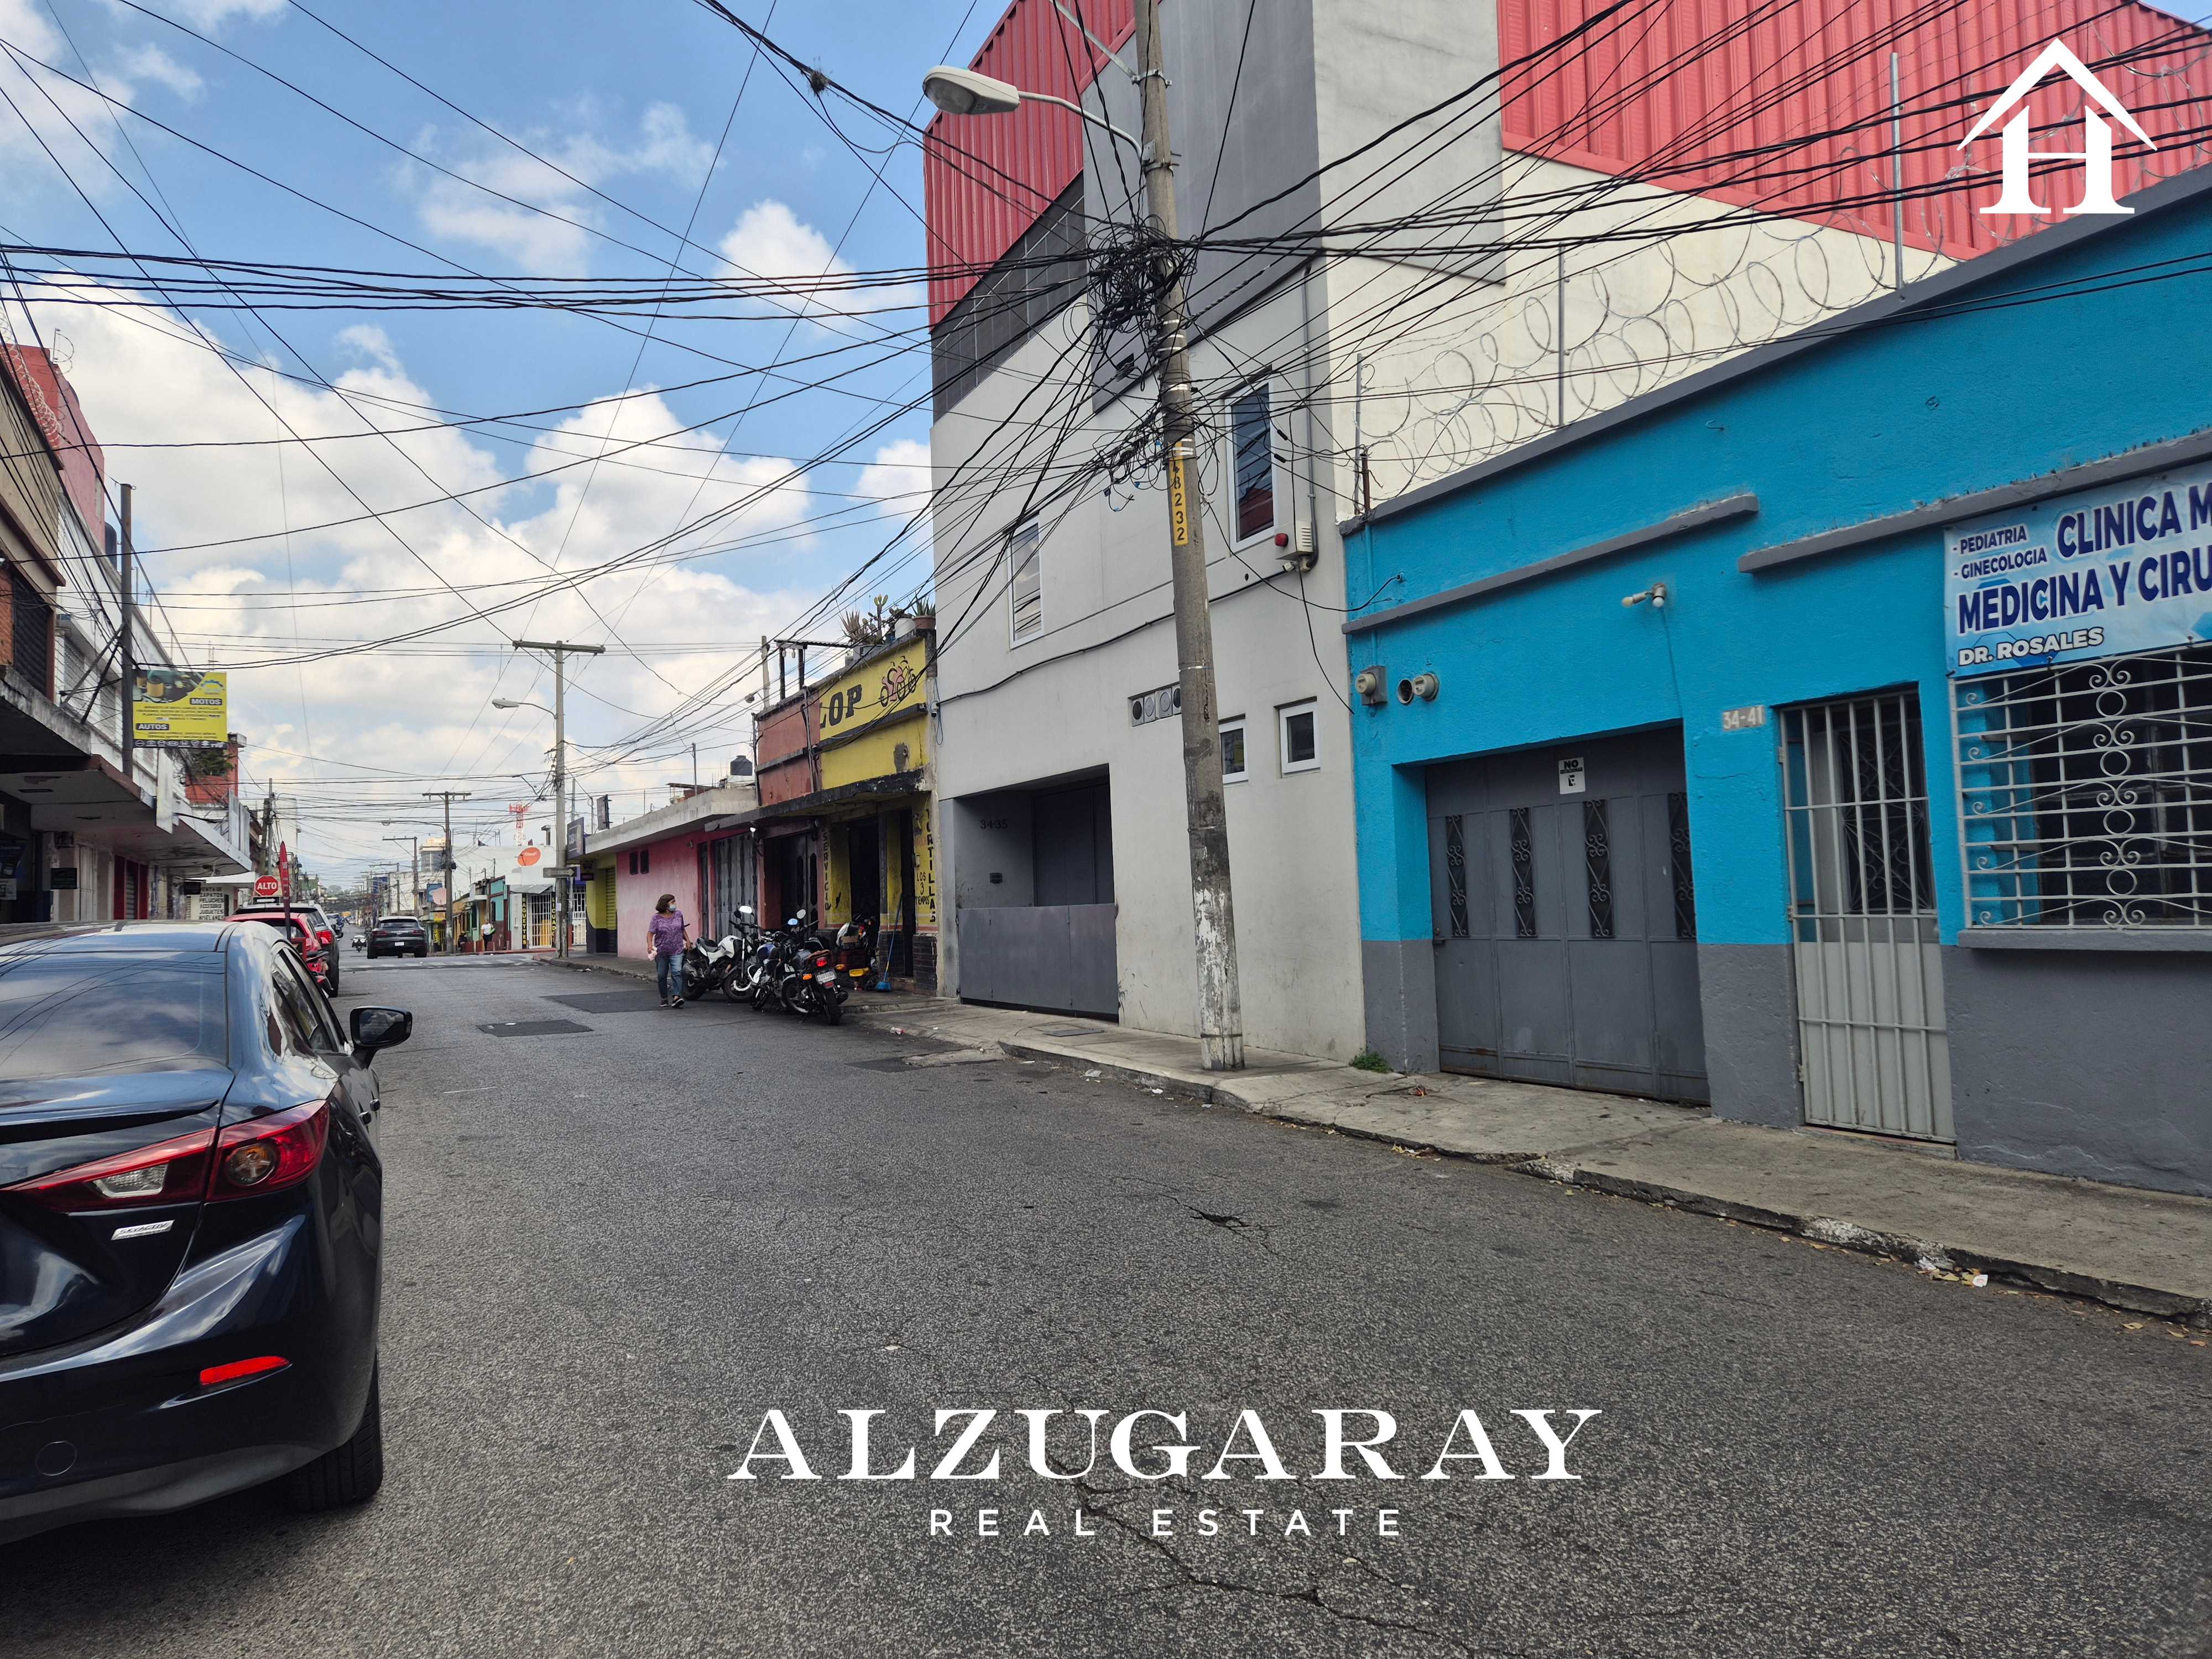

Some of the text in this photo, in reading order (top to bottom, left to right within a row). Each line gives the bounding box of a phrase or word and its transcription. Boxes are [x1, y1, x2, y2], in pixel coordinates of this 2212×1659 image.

[2057, 491, 2182, 558] CLINICA
[1960, 526, 2027, 554] PEDIATRIA
[1961, 547, 2047, 579] GINECOLOGIA
[1959, 545, 2212, 634] MEDICINA Y CIRU
[1958, 627, 2105, 666] DR. ROSALES
[1723, 706, 1763, 729] 34-41
[1564, 759, 1579, 769] NO
[917, 872, 926, 881] LOS
[920, 882, 925, 895] 3
[915, 895, 930, 906] TIEMPOS
[119, 1222, 170, 1234] SKYACTIV
